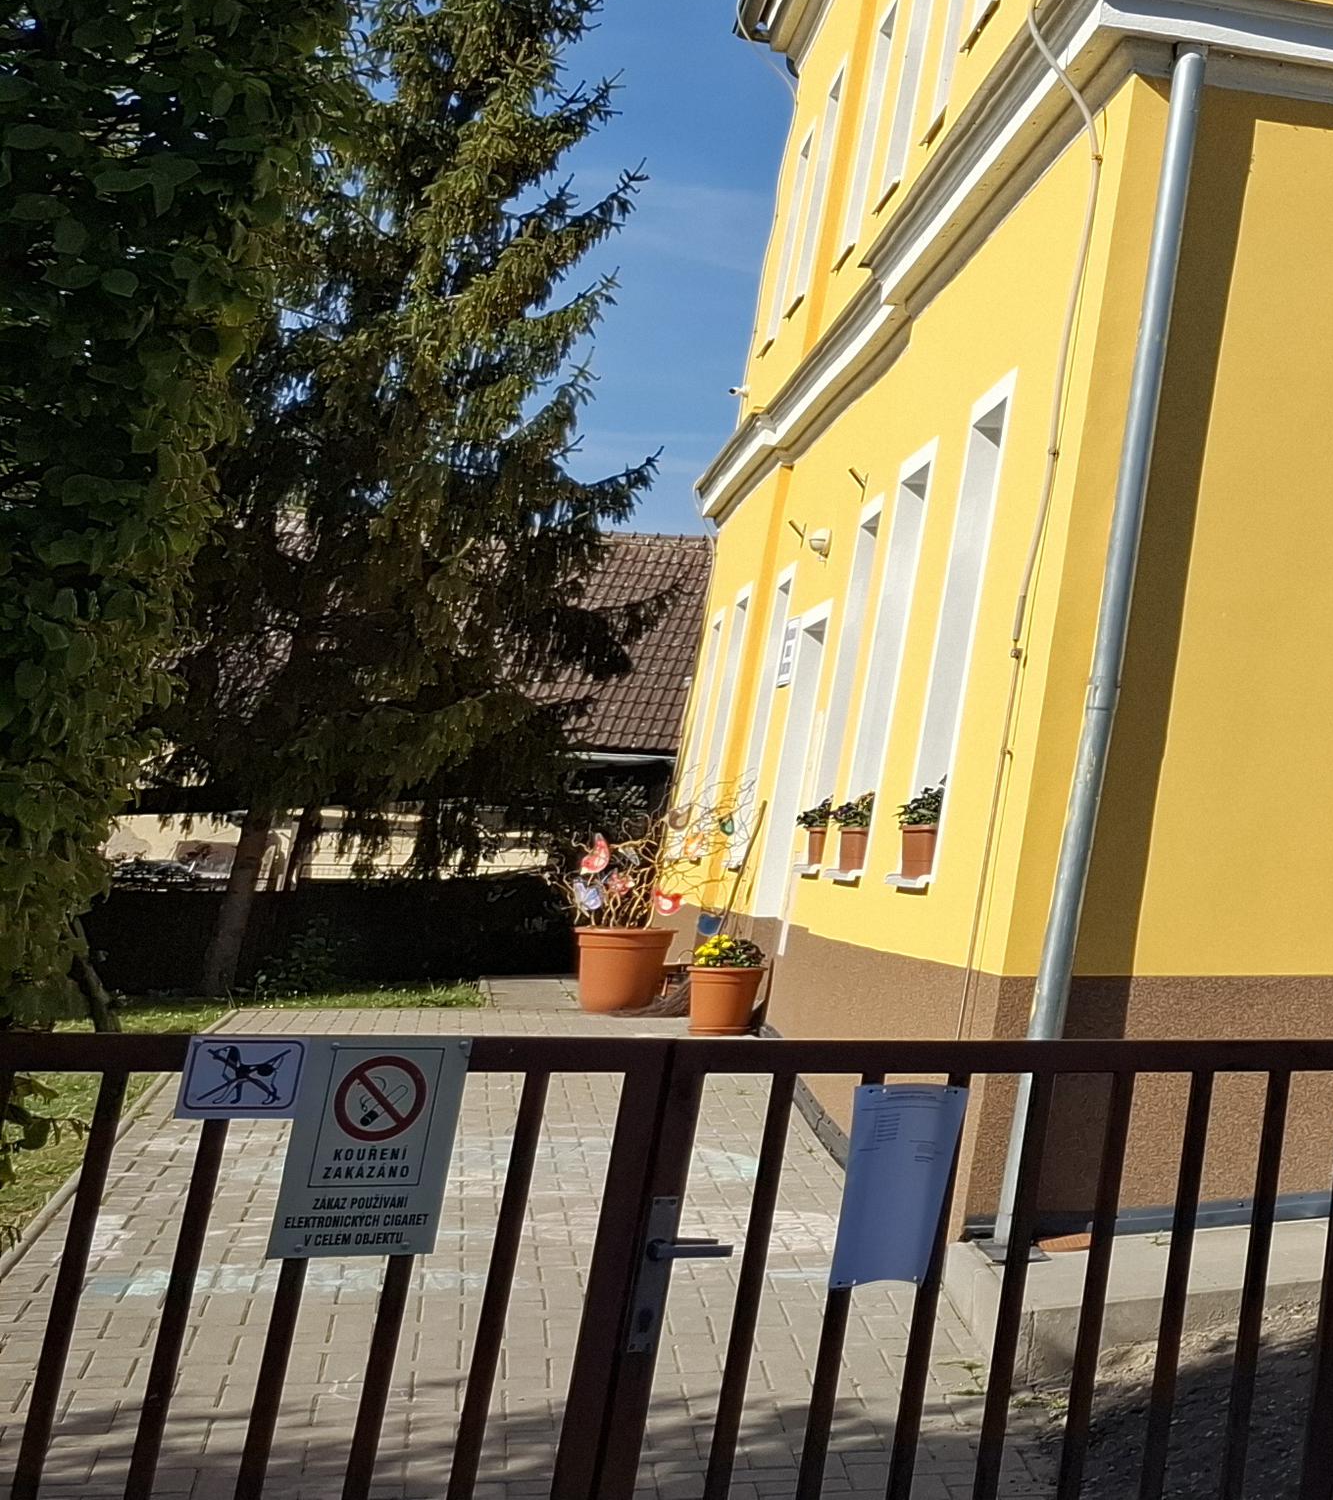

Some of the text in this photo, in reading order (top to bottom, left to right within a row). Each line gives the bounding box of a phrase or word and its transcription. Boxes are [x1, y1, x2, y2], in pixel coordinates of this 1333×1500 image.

[333, 1145, 408, 1161] KOUŘENÍ
[322, 1163, 409, 1179] ZAKÁZÁNO
[312, 1194, 408, 1210] ZÁKAZ POUŽÍVÁNÍ
[284, 1213, 429, 1228] ELEKTRONICKÝCH CIGARET
[304, 1231, 404, 1247] V CELÉM OBJEKTU
